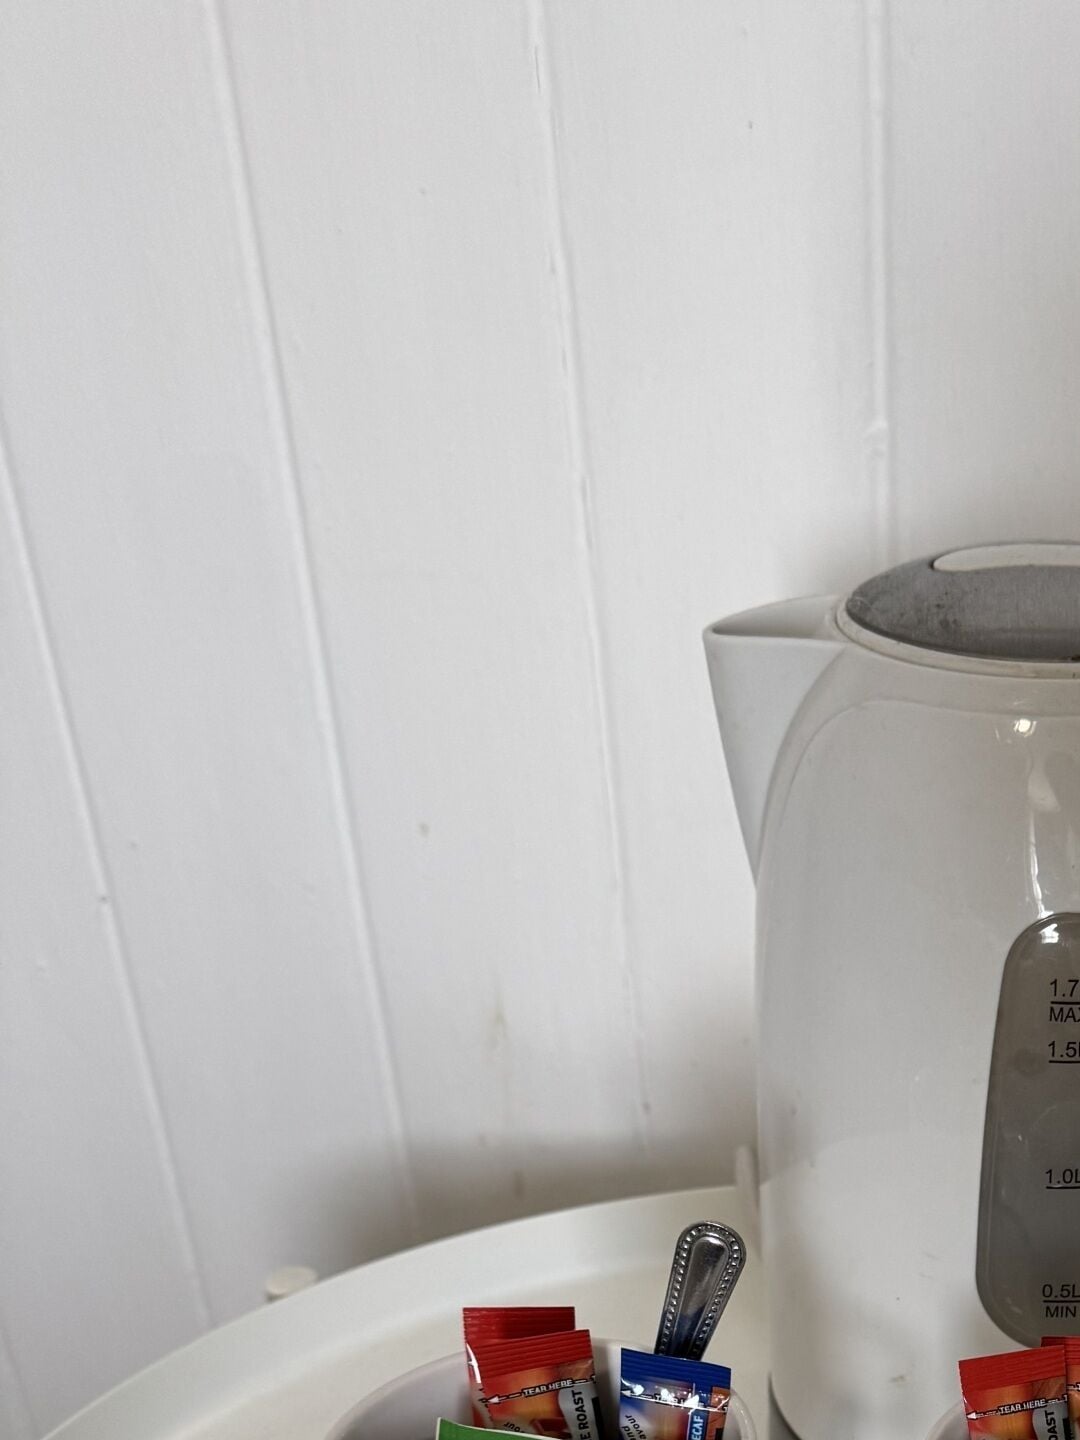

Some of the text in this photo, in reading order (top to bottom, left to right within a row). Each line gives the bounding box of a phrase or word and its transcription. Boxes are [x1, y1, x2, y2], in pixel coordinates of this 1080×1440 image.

[1045, 1305, 1077, 1318] MIN
[523, 1379, 574, 1397] TEAR HERE
[571, 1389, 590, 1433] ROAST
[1000, 1398, 1046, 1415] TEAR HERE
